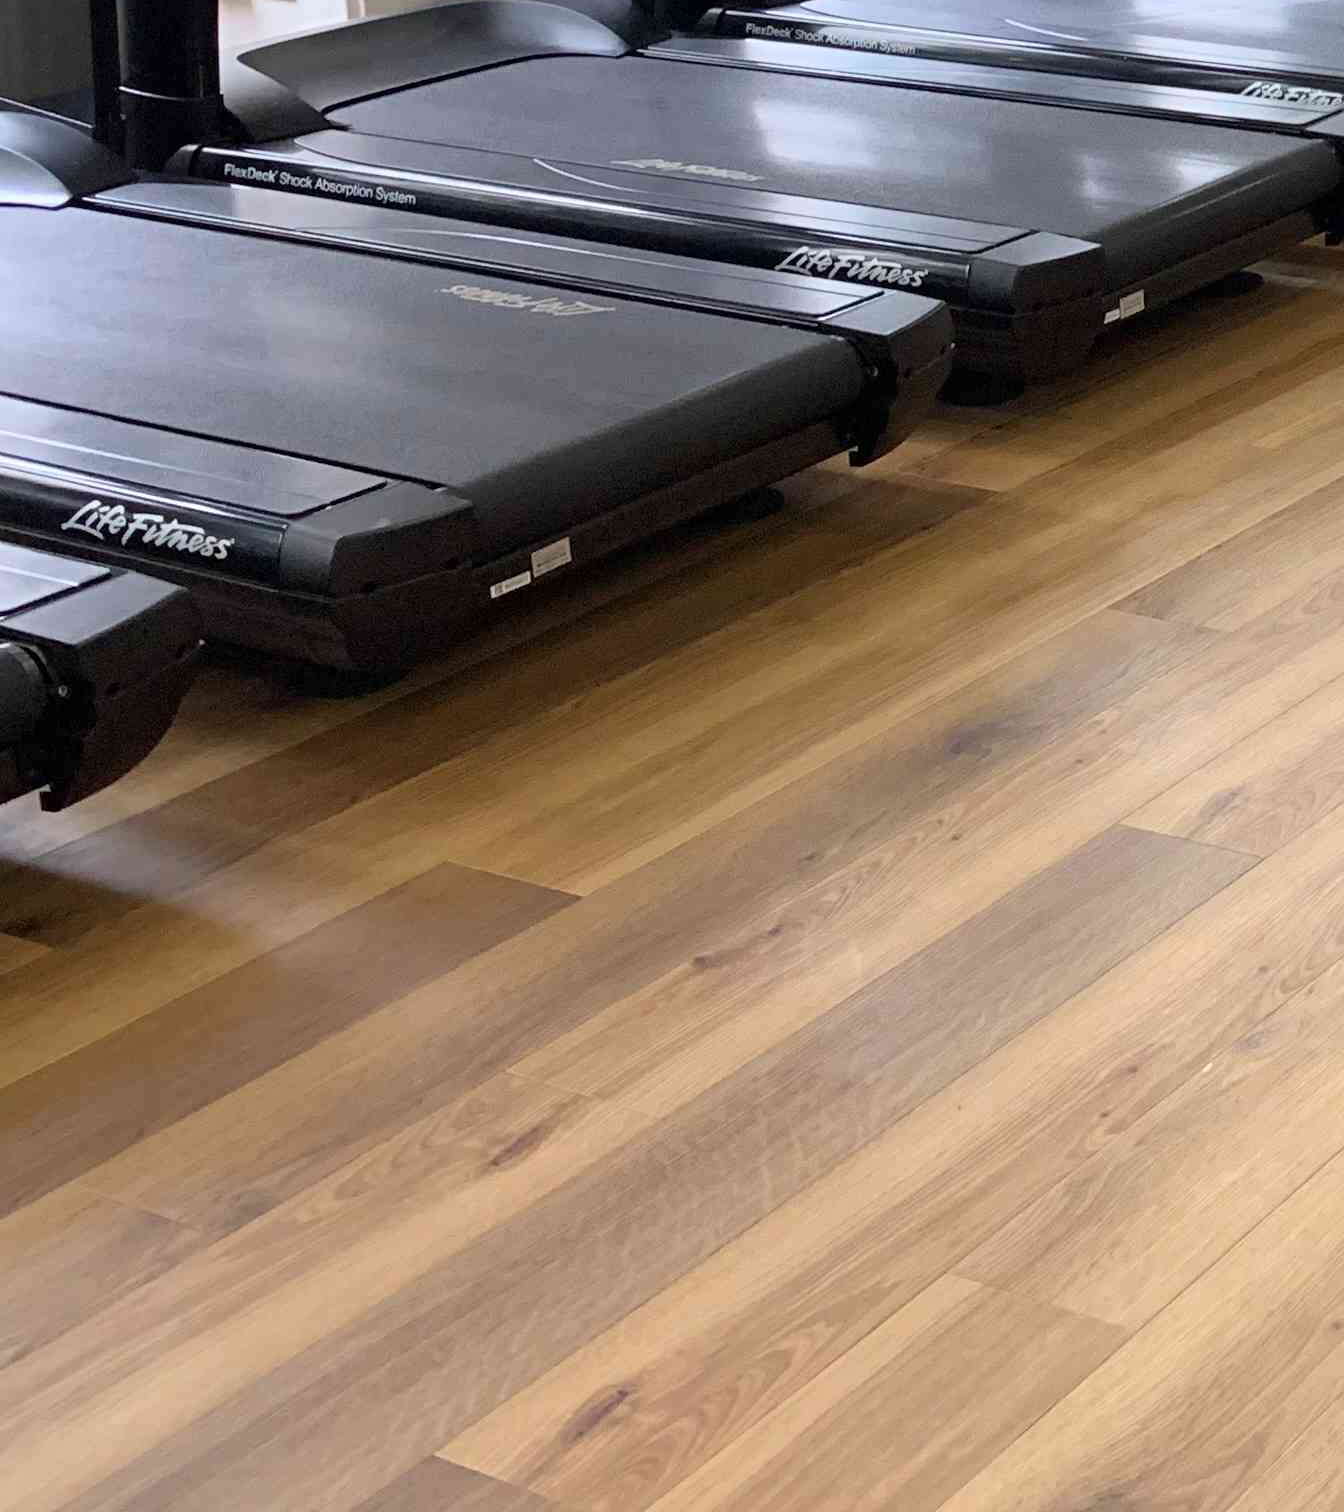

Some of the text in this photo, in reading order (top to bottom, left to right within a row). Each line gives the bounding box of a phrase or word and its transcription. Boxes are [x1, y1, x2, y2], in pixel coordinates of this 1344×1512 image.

[224, 163, 417, 205] FlexDeck Shock Absorption System
[774, 246, 927, 287] Life Fitness
[61, 499, 234, 560] Life Fitness
